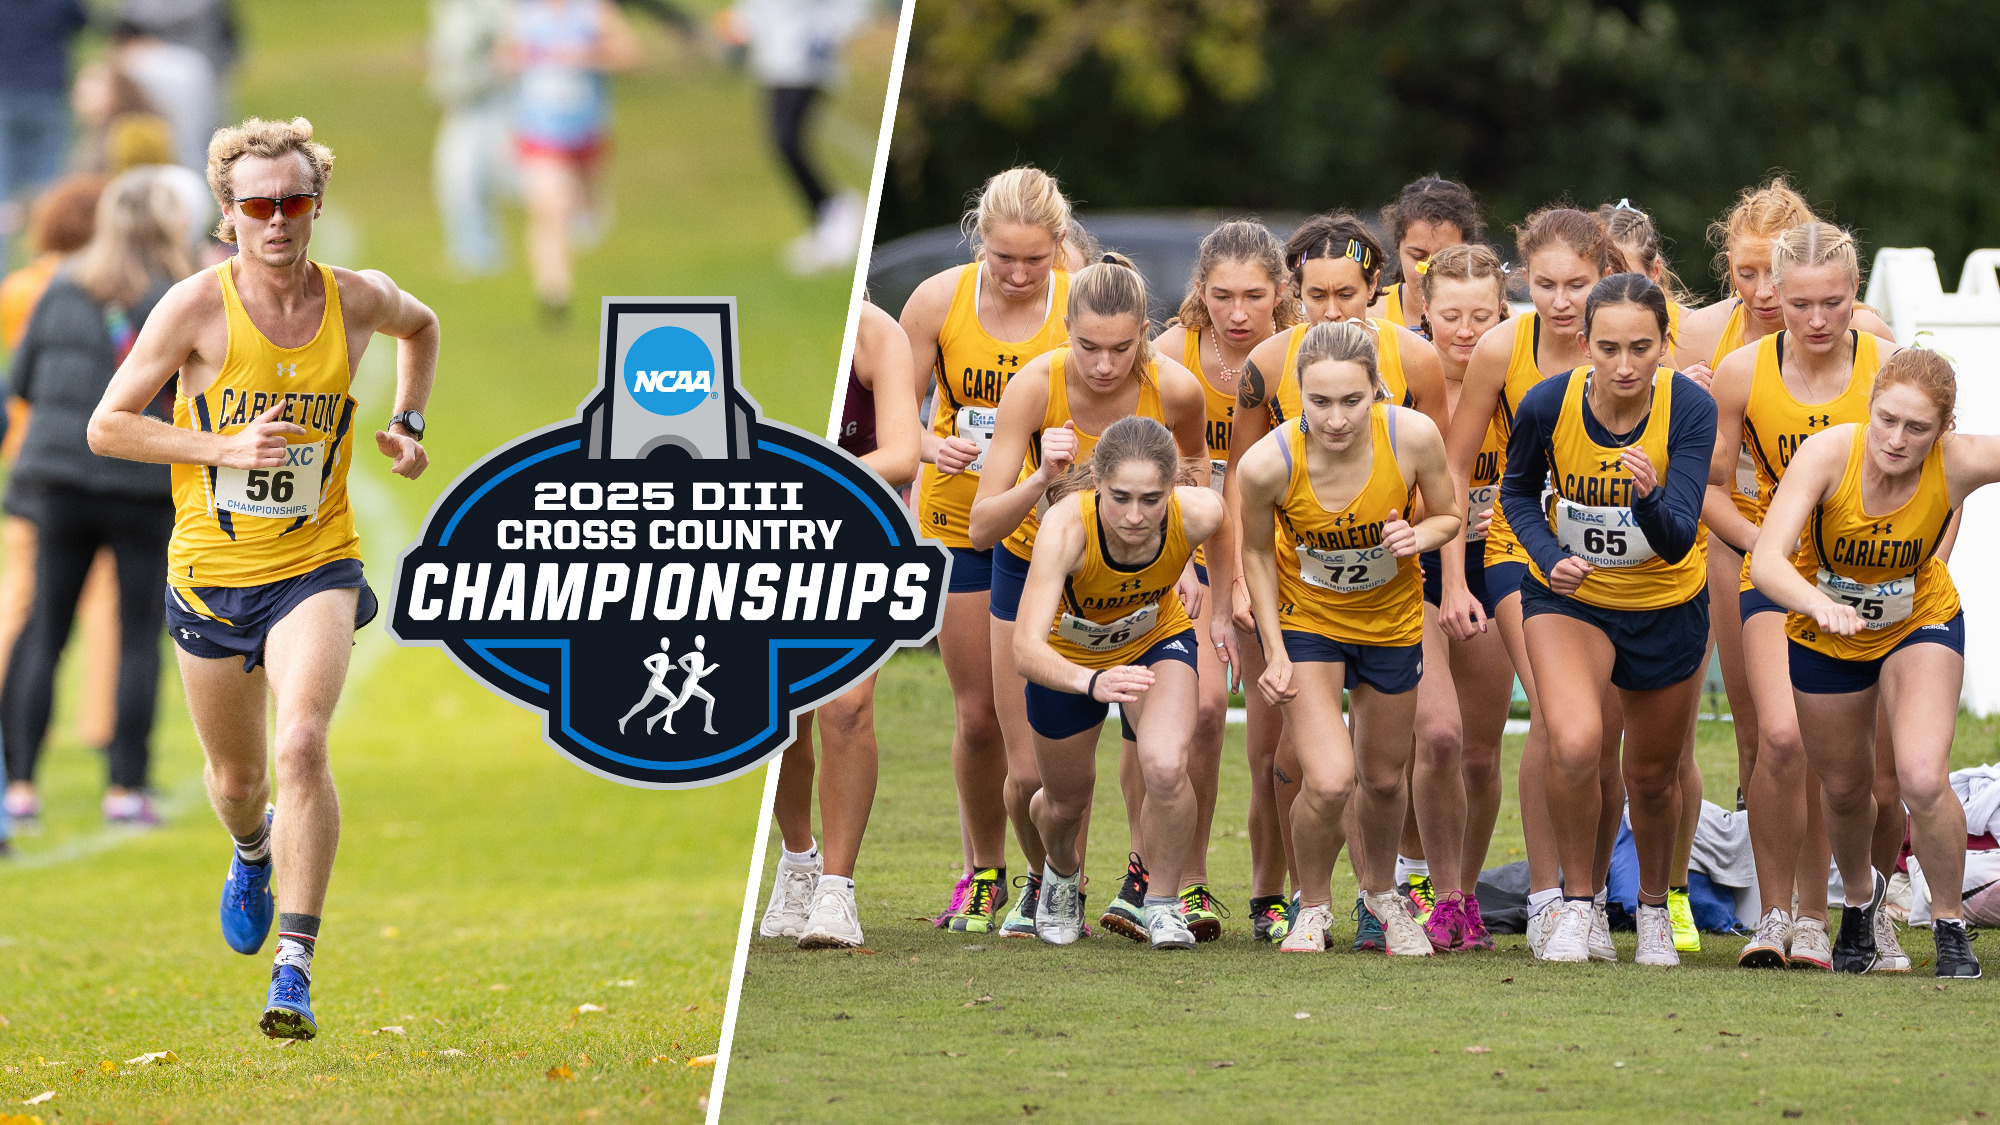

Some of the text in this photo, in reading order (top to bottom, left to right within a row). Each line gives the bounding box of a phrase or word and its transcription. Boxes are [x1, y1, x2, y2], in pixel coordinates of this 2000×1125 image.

[246, 469, 295, 503] 56
[227, 499, 308, 515] CHAMPIONSHIPS
[932, 511, 947, 526] 30
[1572, 509, 1604, 524] MIAC
[1584, 528, 1628, 557] 65
[1355, 547, 1384, 563] XC
[1833, 537, 1923, 568] CARLETON
[188, 565, 194, 579] 1
[1323, 564, 1370, 585] 72
[1312, 575, 1387, 592] CHAMPIONSHIPS
[1876, 580, 1903, 597] XC
[1841, 595, 1884, 621] 75
[1123, 610, 1149, 628] XC
[1088, 628, 1131, 646] 76
[1801, 629, 1816, 643] 22
